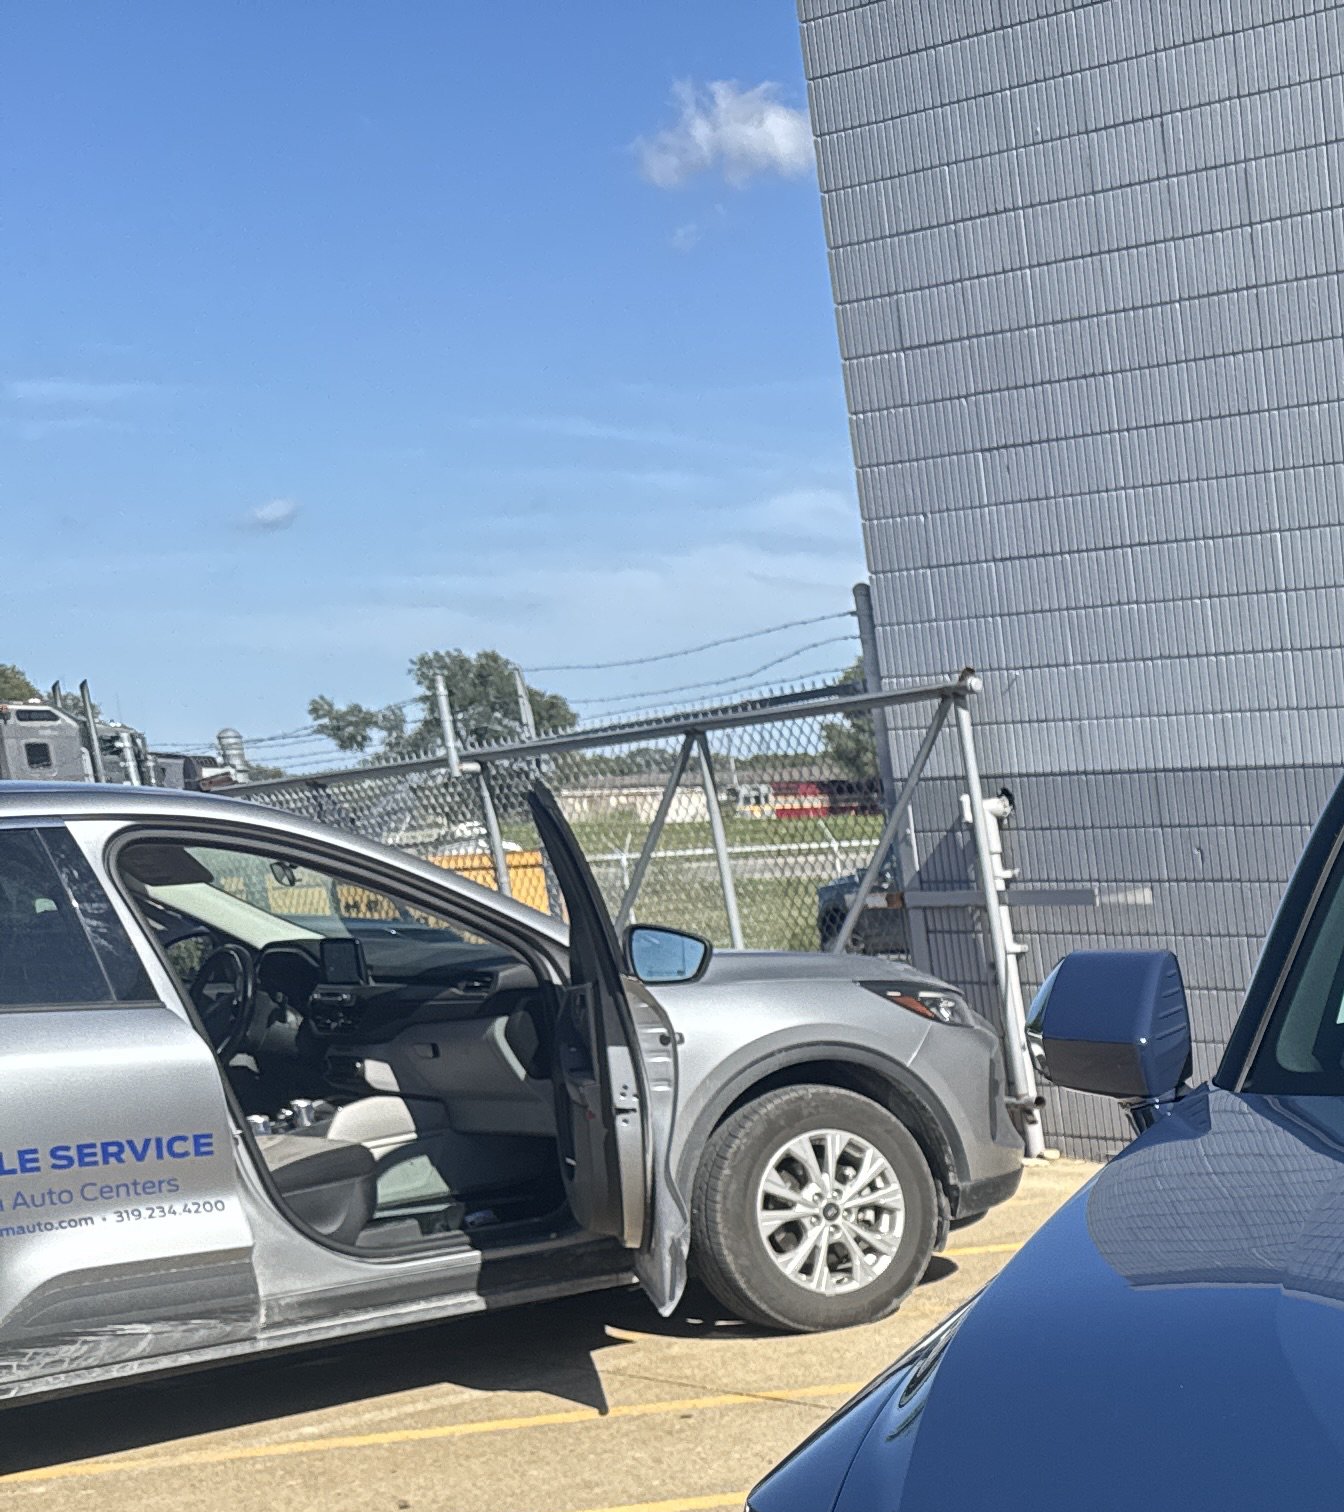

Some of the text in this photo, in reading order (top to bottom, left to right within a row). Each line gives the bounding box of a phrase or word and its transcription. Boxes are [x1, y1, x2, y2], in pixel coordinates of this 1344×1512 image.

[50, 1133, 215, 1171] SERVICE
[12, 1187, 74, 1212] Auto
[80, 1176, 180, 1202] Centers
[115, 1199, 226, 1224] 319.234.4200
